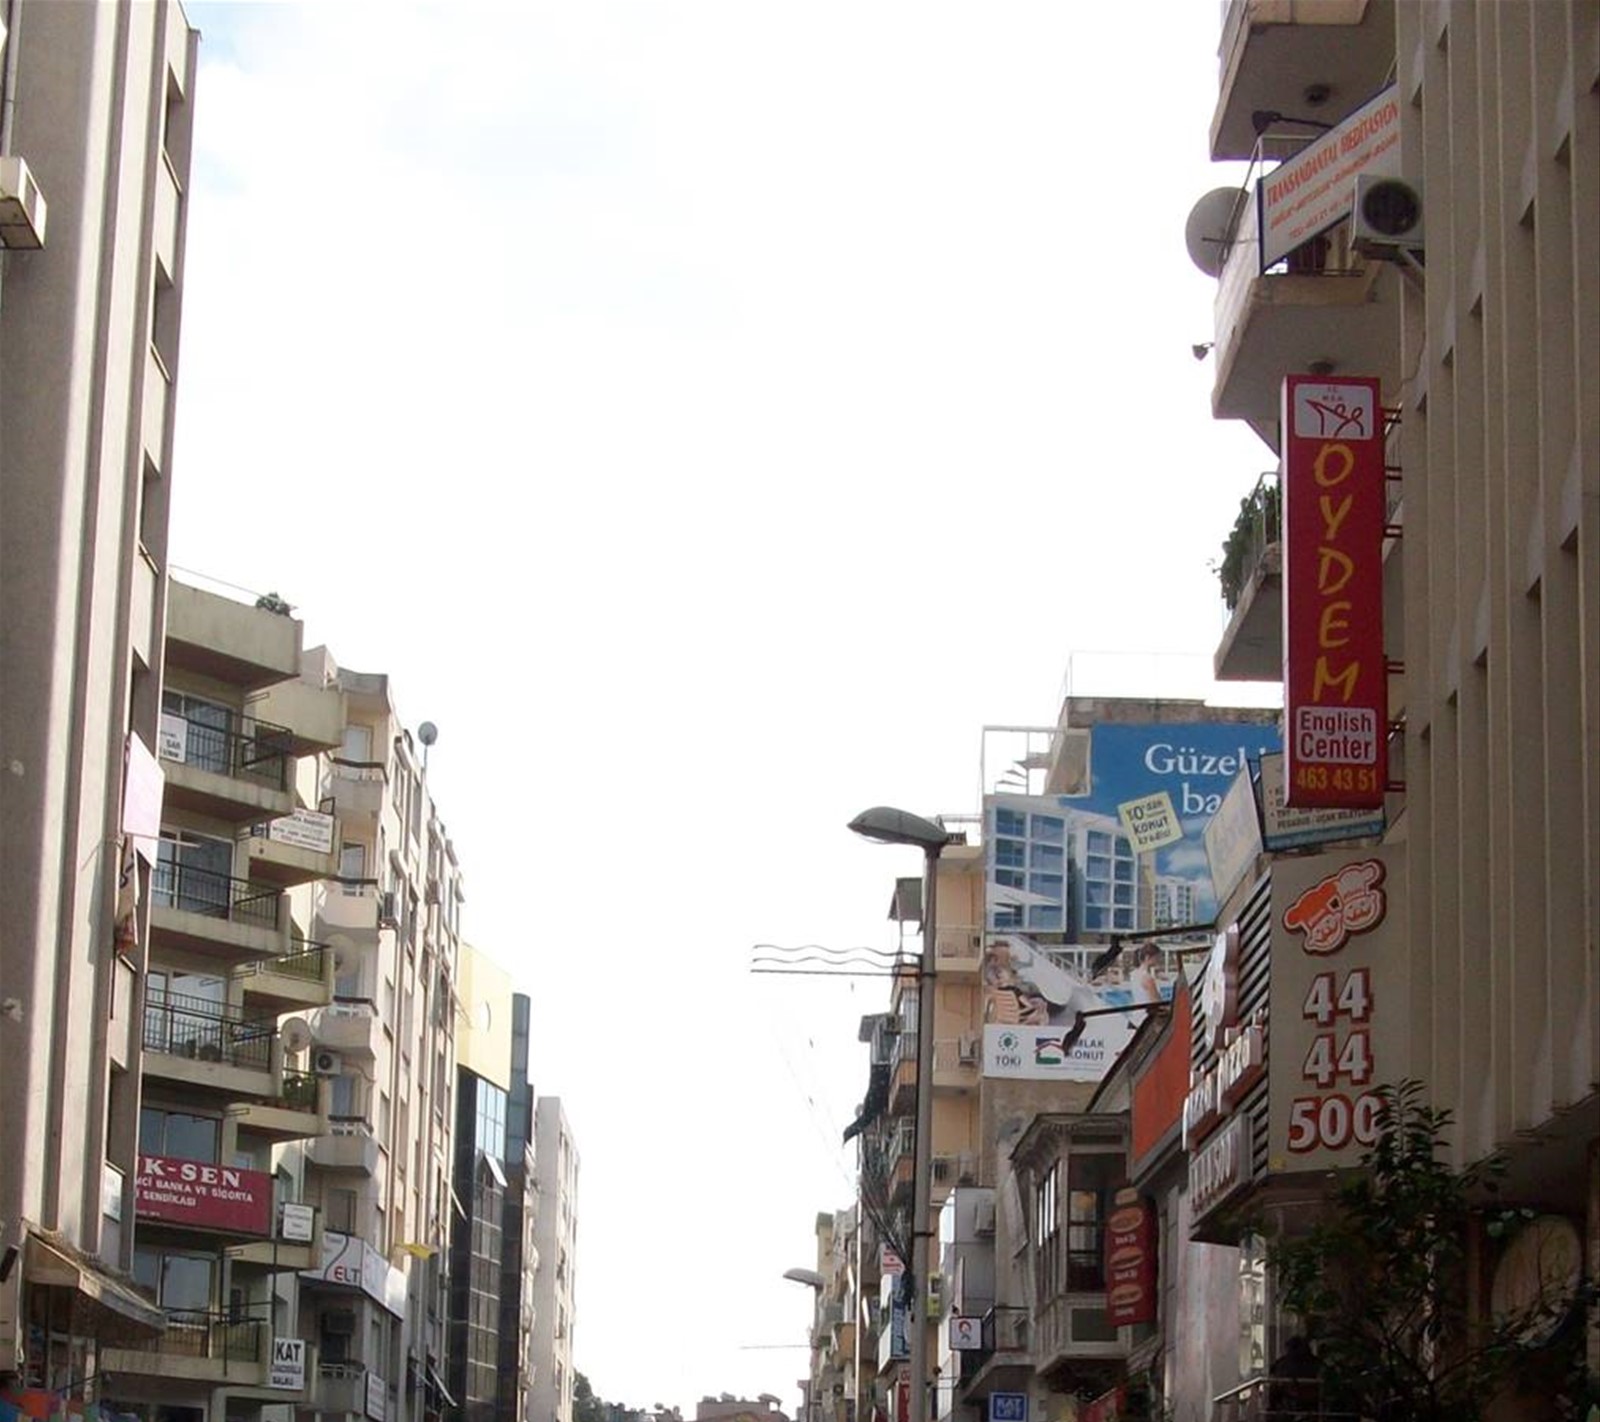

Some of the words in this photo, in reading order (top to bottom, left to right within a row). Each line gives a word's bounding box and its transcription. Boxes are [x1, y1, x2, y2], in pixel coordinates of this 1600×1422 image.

[1313, 442, 1360, 703] OYDEM
[1300, 711, 1372, 735] English
[1300, 732, 1372, 759] Center
[1296, 767, 1327, 790] 463
[1333, 769, 1353, 791] 43
[1358, 769, 1377, 791] 51
[1304, 969, 1370, 1025] 44
[1304, 1032, 1370, 1086] 44
[1290, 1093, 1381, 1151] 500
[145, 1157, 241, 1188] K-SEN
[156, 1179, 191, 1196] BANKA
[195, 1185, 207, 1196] VE
[275, 1341, 301, 1362] KAT
